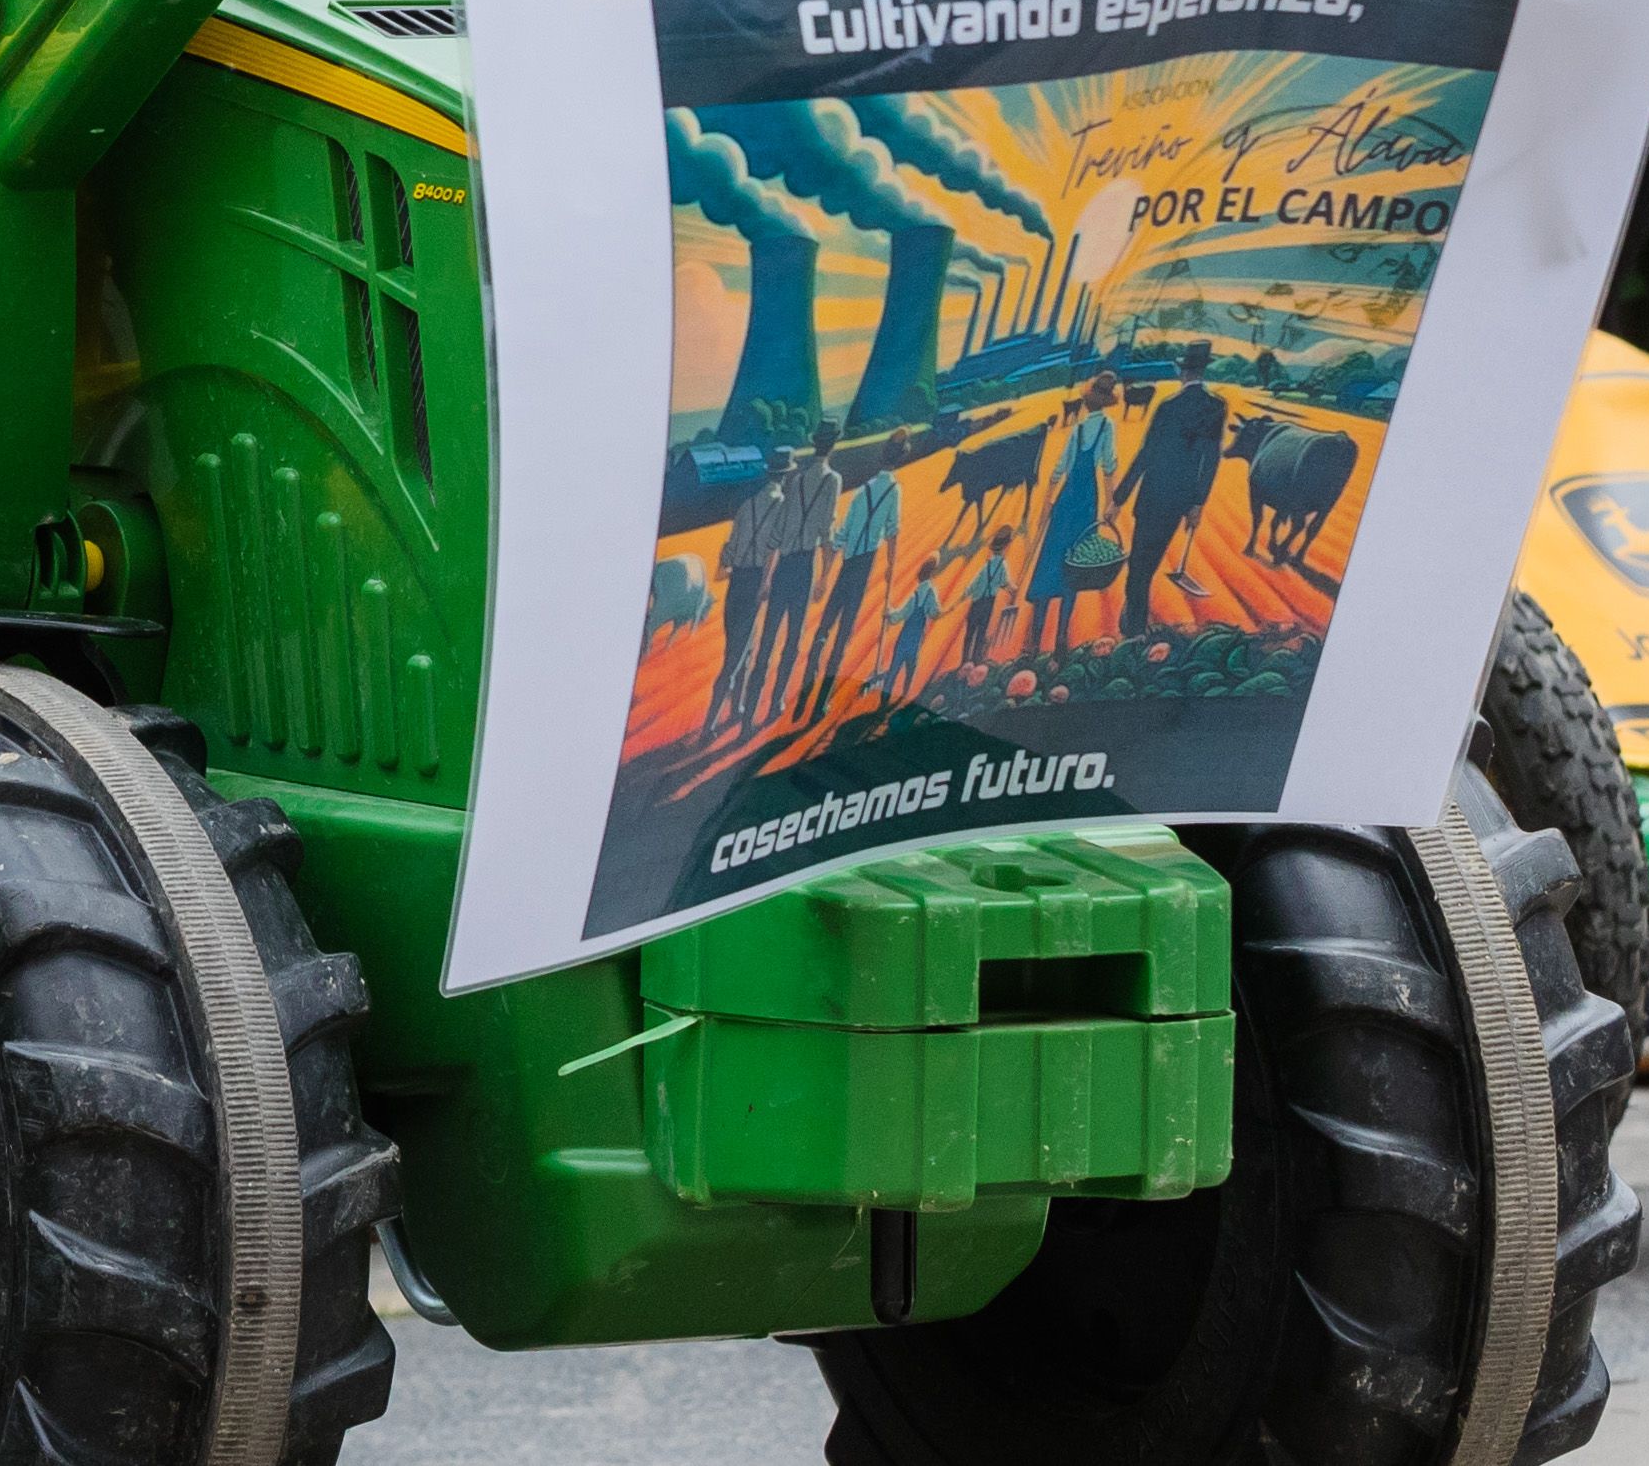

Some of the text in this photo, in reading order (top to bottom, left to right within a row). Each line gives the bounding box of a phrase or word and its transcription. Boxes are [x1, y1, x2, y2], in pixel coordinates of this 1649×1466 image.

[1130, 187, 1451, 237] POR EL CAMPO
[710, 750, 1116, 874] cosechamos futuro.
